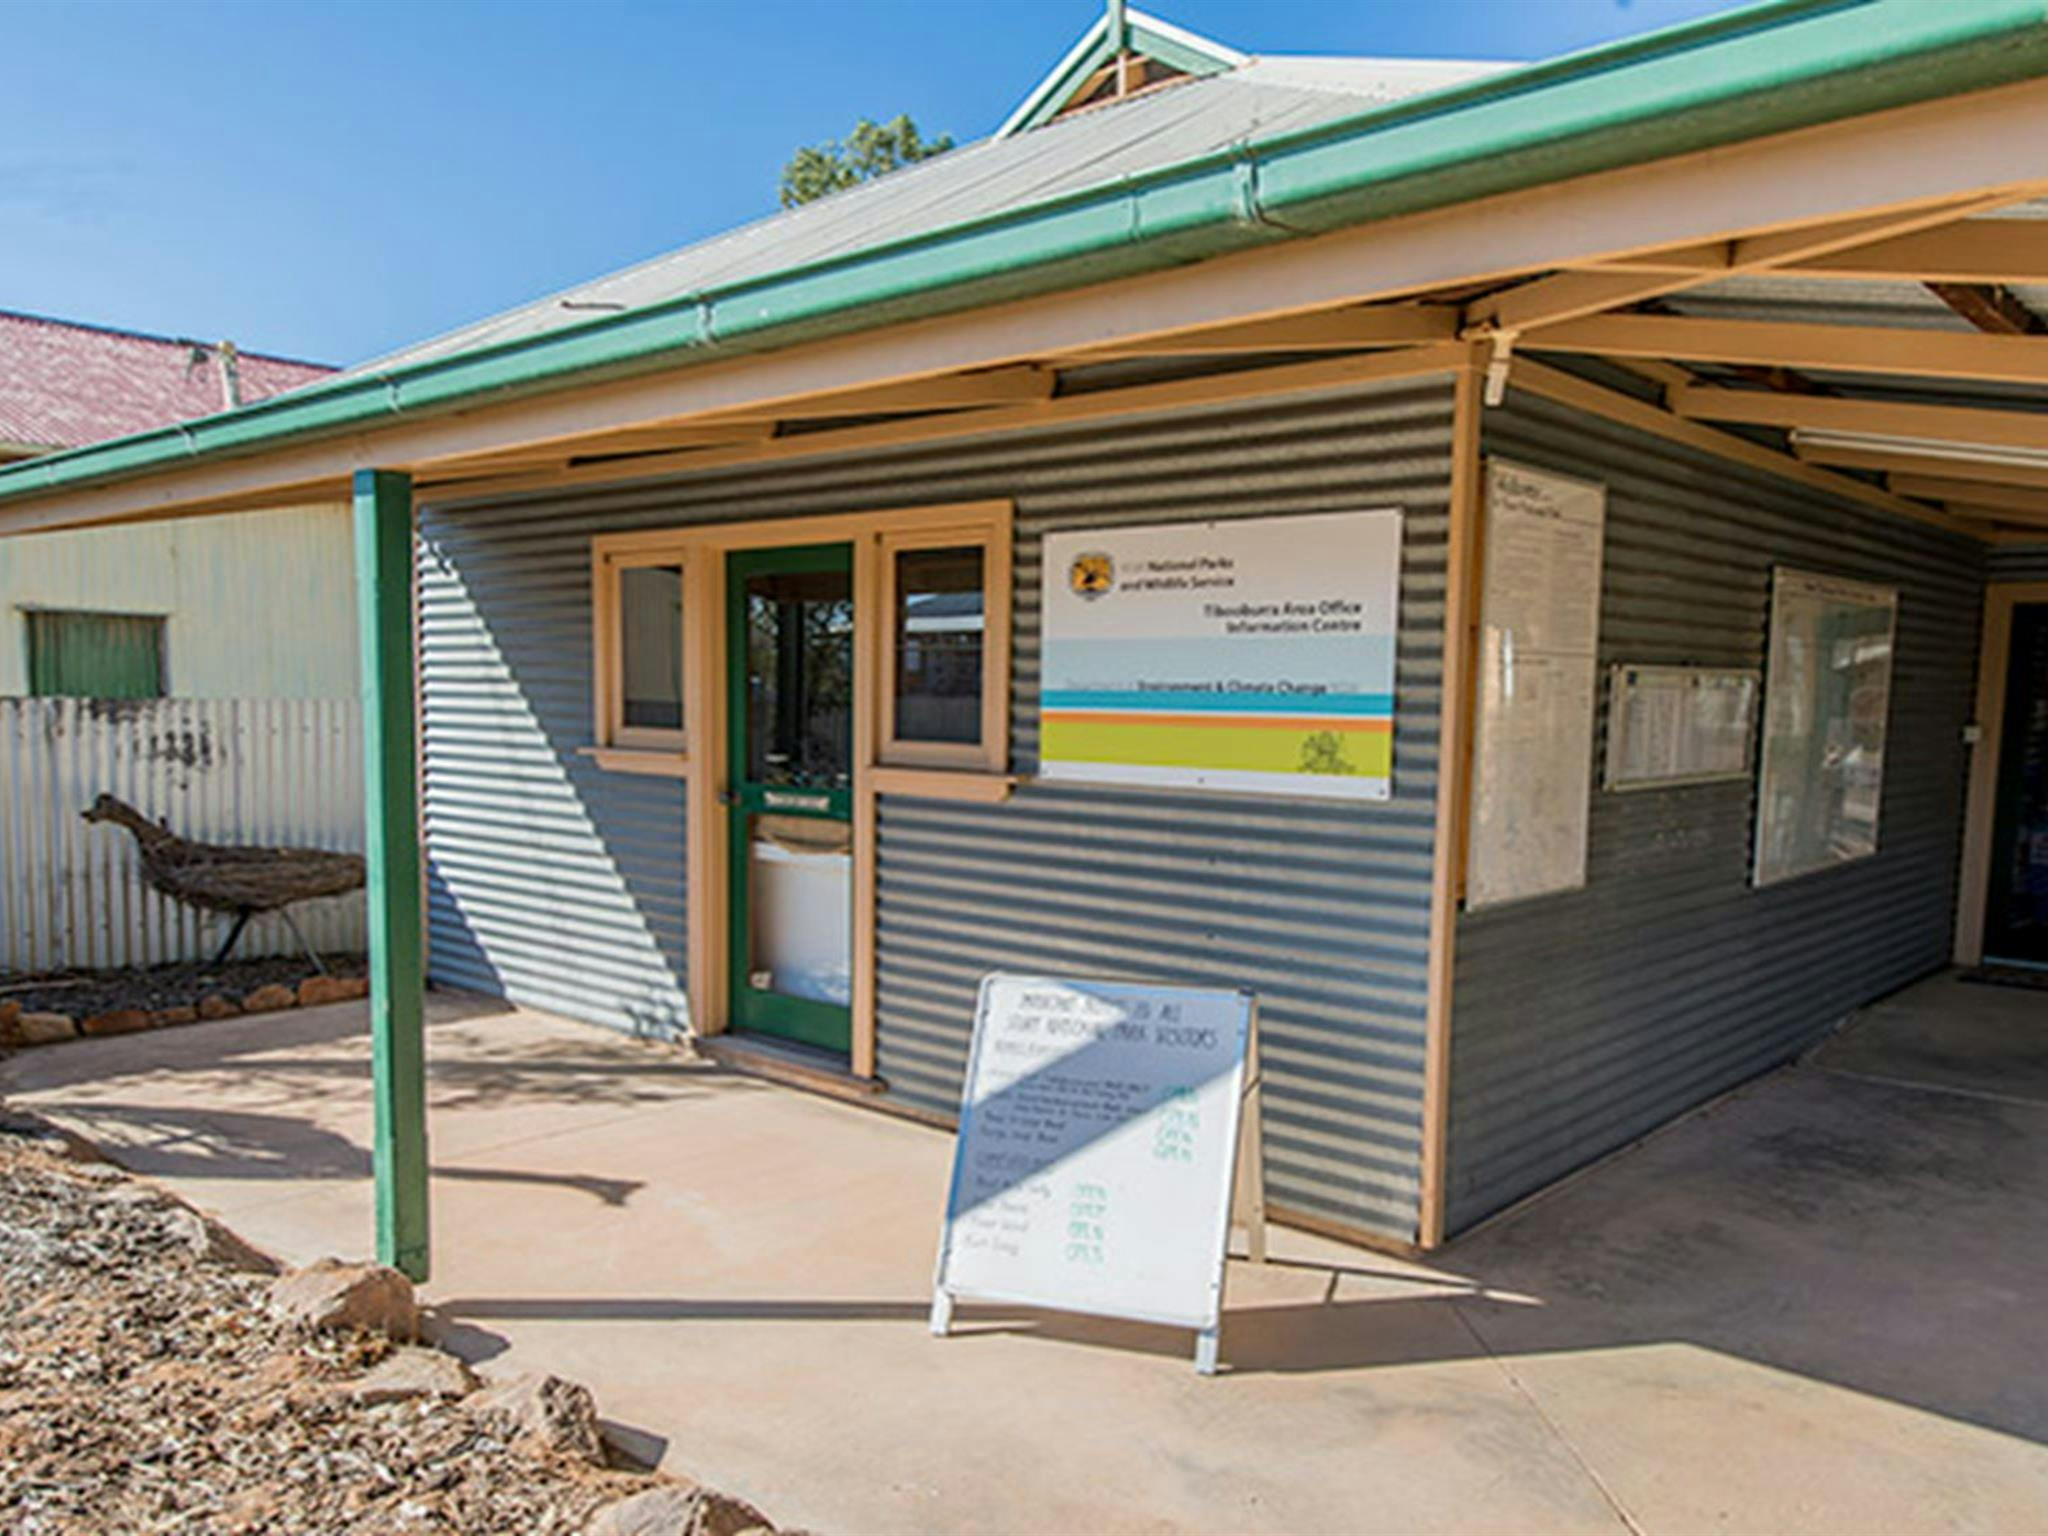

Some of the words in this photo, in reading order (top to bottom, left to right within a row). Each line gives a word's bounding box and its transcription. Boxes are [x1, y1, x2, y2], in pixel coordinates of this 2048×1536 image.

[1191, 575, 1234, 588] Service
[1319, 600, 1361, 614] Office
[1226, 620, 1308, 633] Information
[1313, 617, 1361, 632] Centre
[1227, 681, 1274, 693] Climate
[1279, 681, 1326, 697] Change
